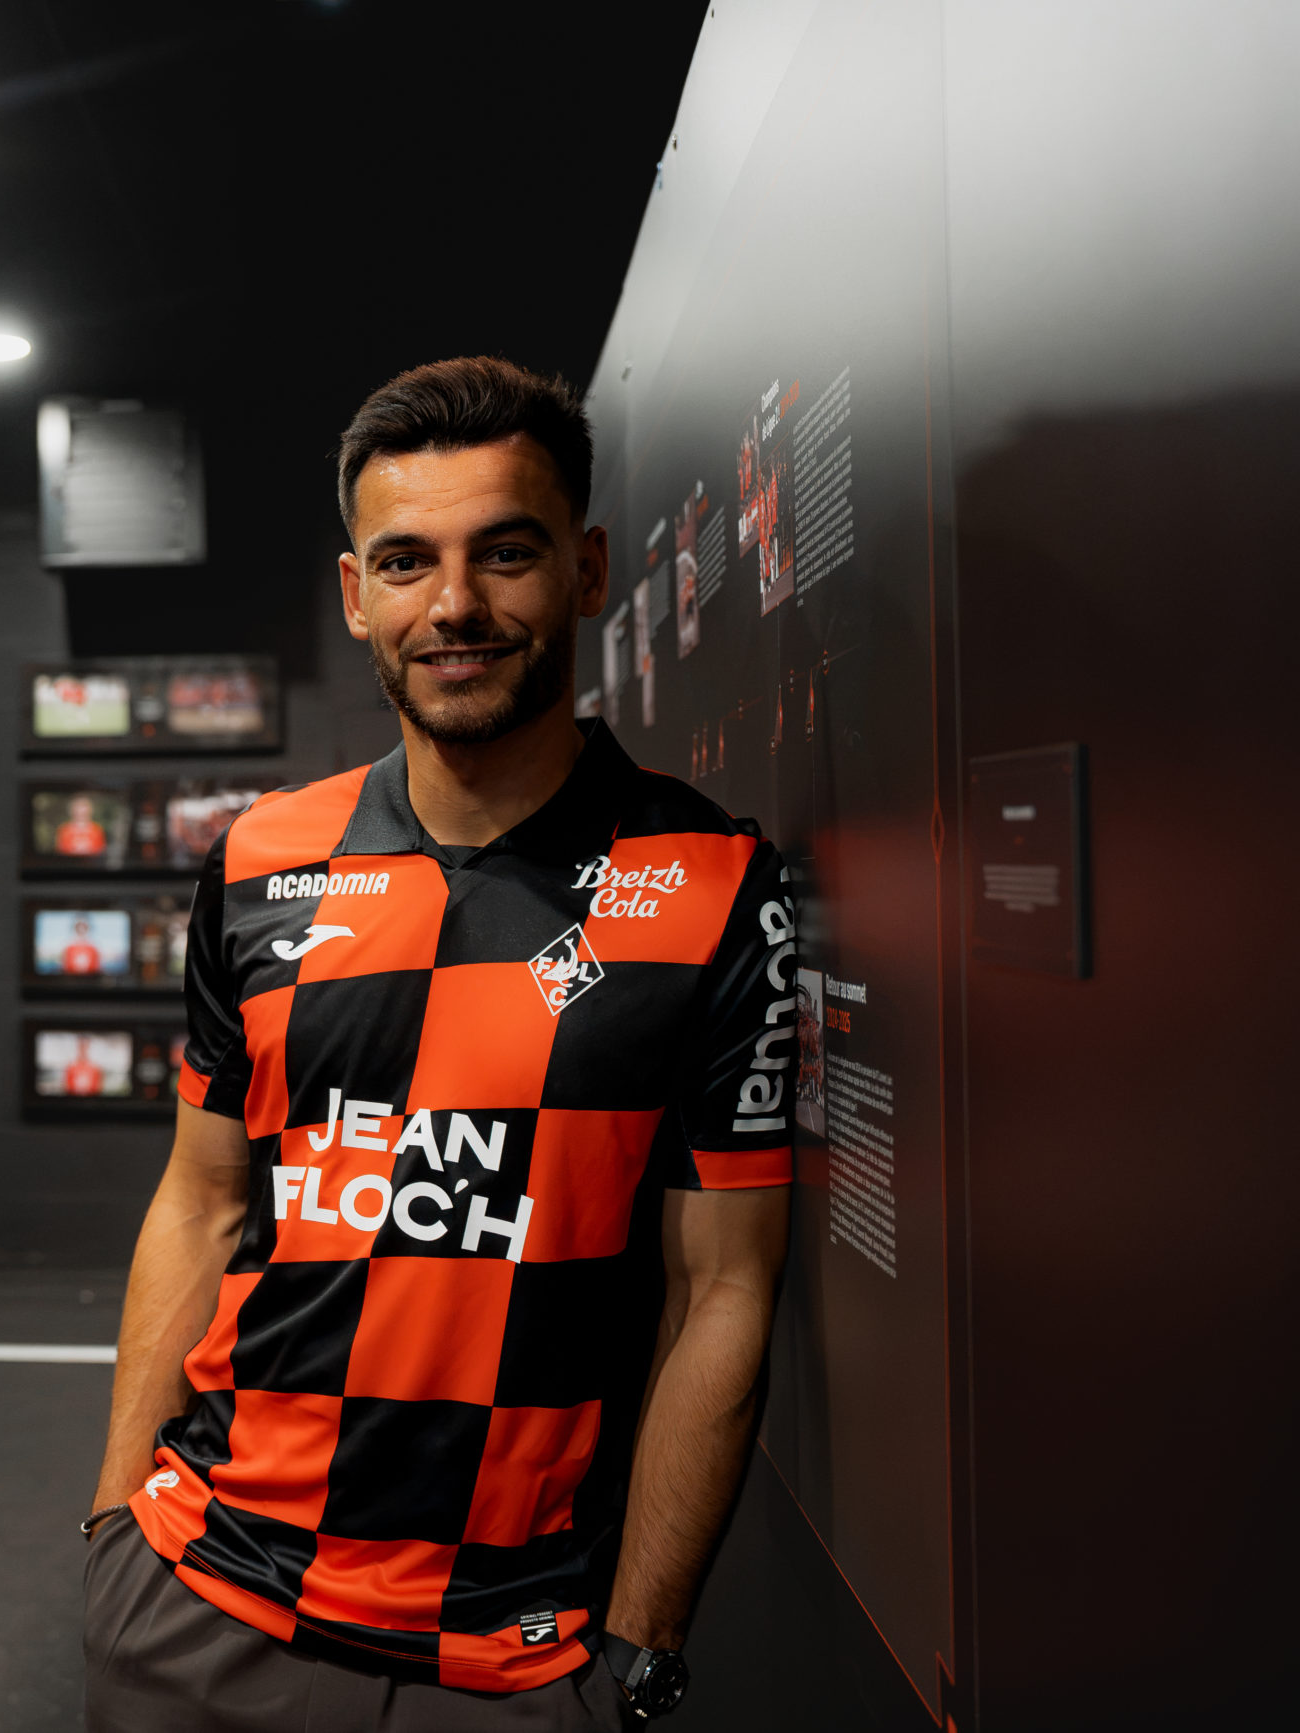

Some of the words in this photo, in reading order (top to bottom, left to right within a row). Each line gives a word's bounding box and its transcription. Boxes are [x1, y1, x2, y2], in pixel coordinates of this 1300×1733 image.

[267, 872, 390, 900] ACADOMIA
[571, 855, 688, 894] Breizh
[589, 888, 660, 918] Cola
[307, 1087, 507, 1172] JEAN
